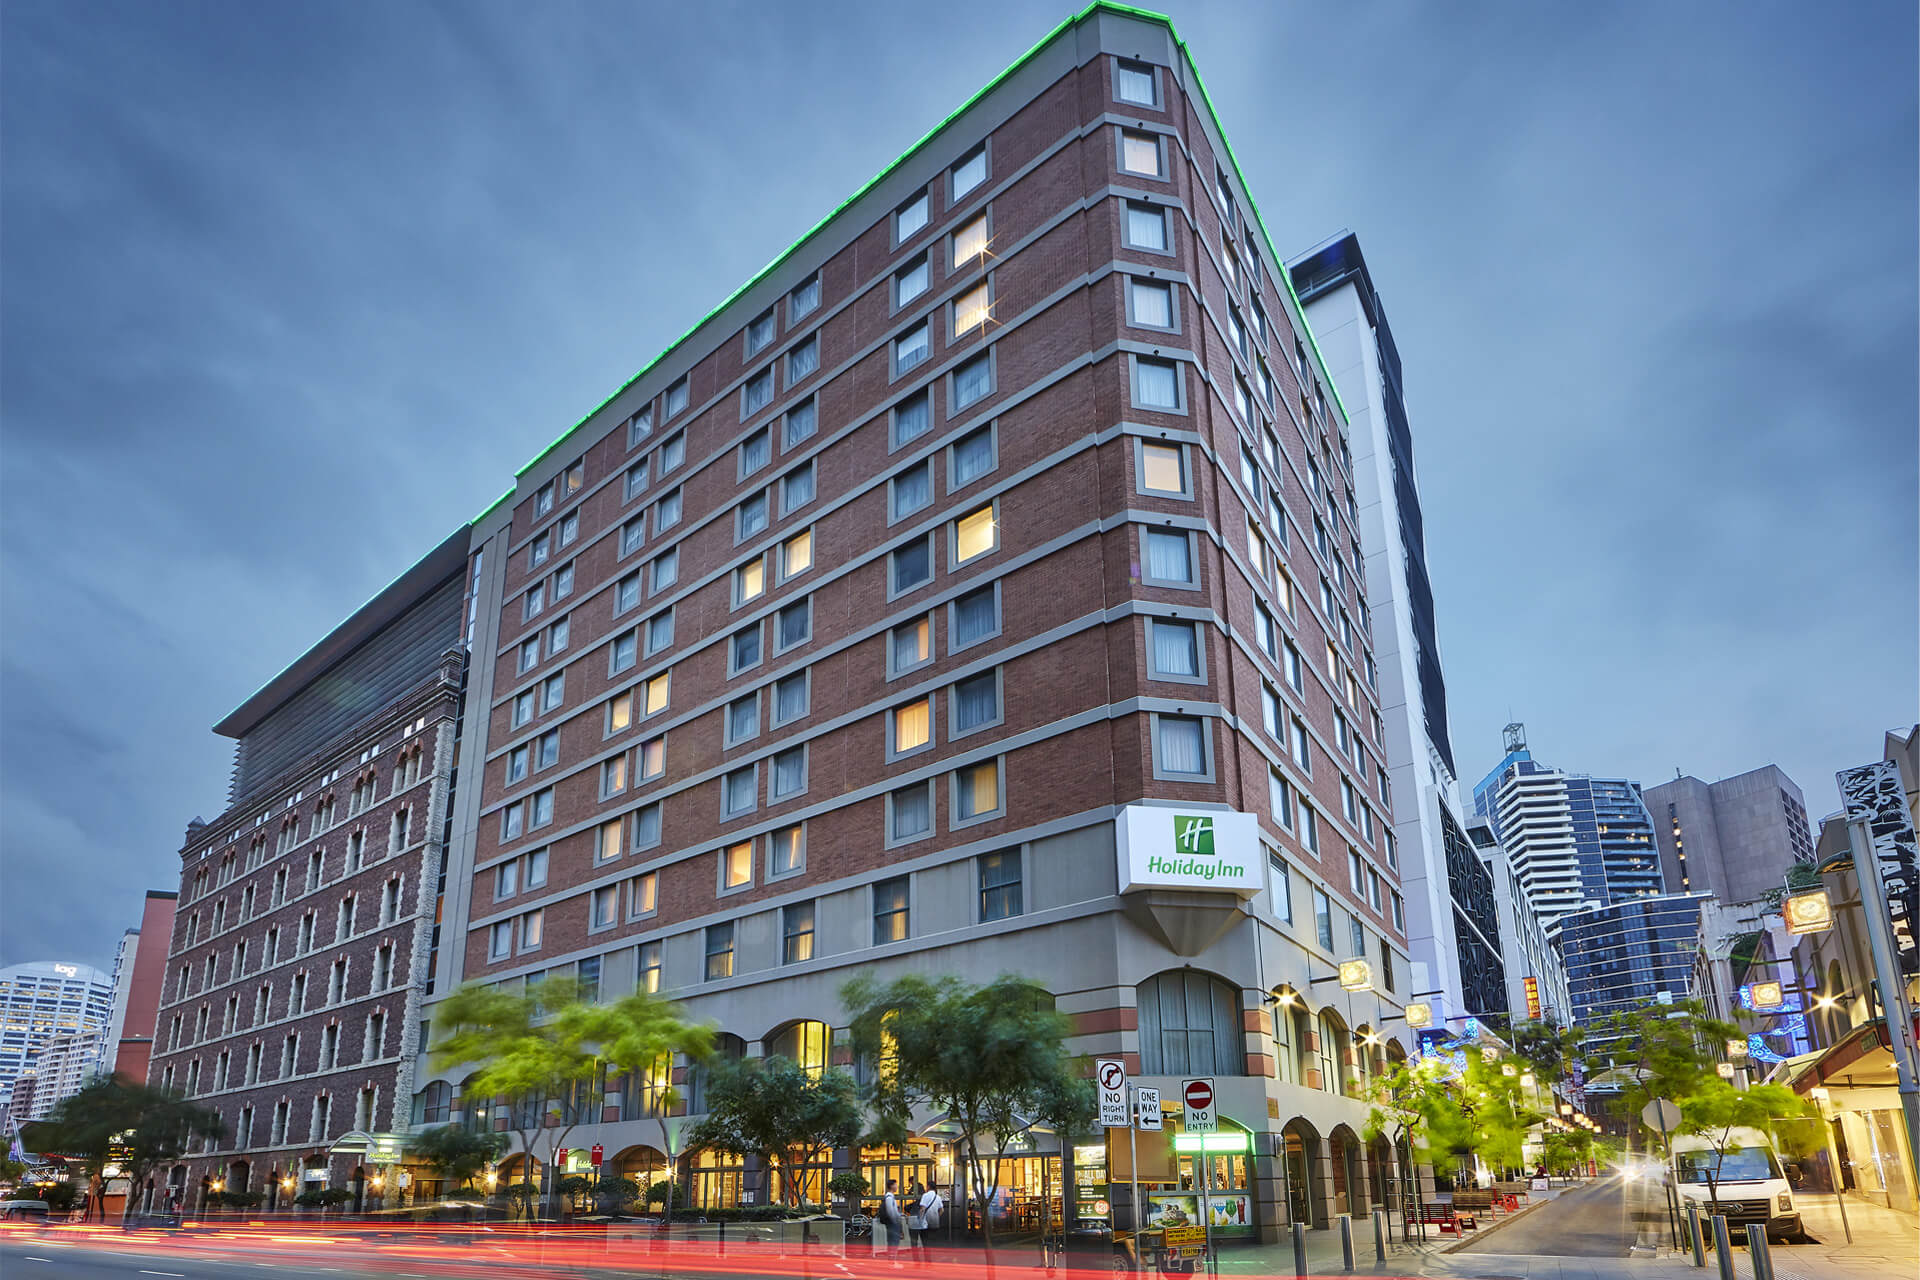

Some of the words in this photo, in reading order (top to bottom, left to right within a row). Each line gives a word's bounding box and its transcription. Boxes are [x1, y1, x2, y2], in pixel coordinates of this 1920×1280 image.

[1148, 856, 1215, 880] Holiday
[1217, 859, 1244, 877] Inn
[1105, 1092, 1121, 1103] NO
[1141, 1091, 1157, 1102] ONE
[1102, 1105, 1125, 1113] RIGHT
[1141, 1103, 1158, 1113] WAY
[1104, 1114, 1125, 1123] TURN
[1192, 1111, 1209, 1120] NO
[1187, 1122, 1214, 1131] ENTRY
